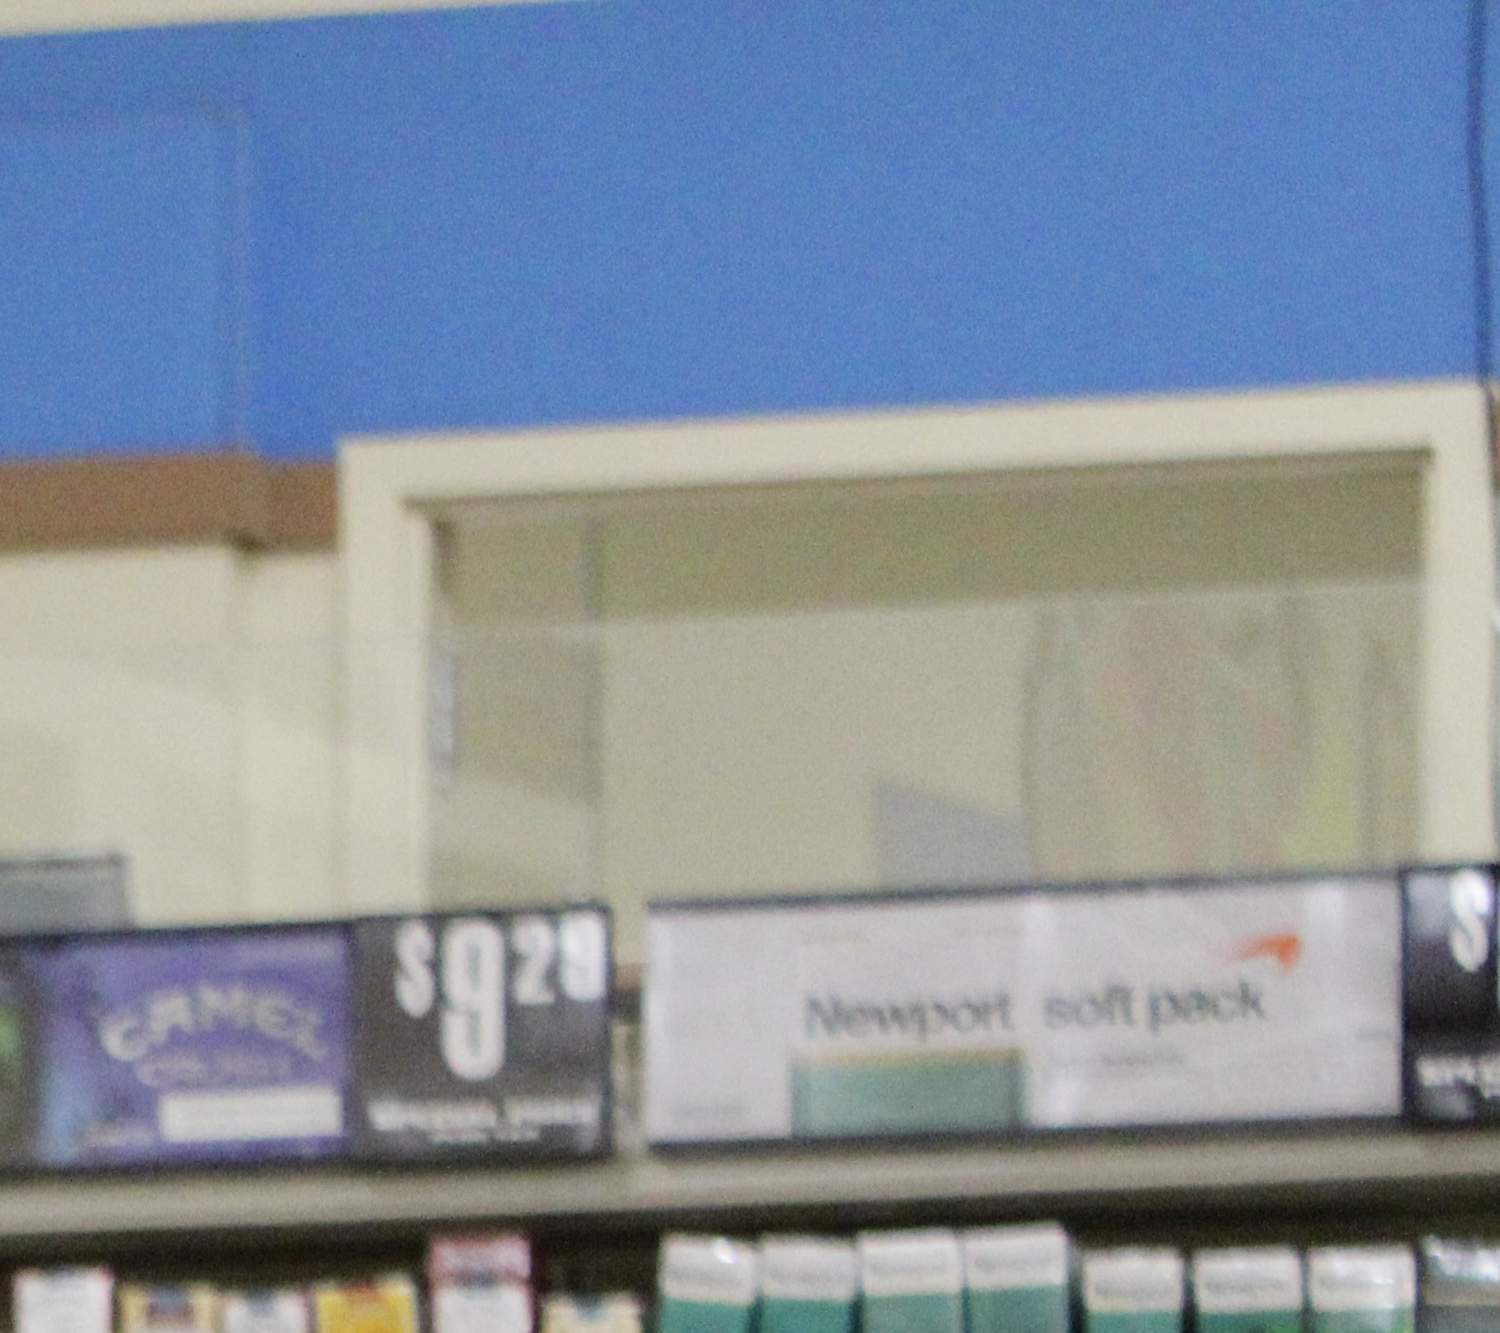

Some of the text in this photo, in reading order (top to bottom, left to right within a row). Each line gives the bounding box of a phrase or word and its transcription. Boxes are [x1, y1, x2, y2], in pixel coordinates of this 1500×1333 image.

[97, 978, 331, 1064] CAMEL
[802, 976, 1268, 1046] Newport soft pack
